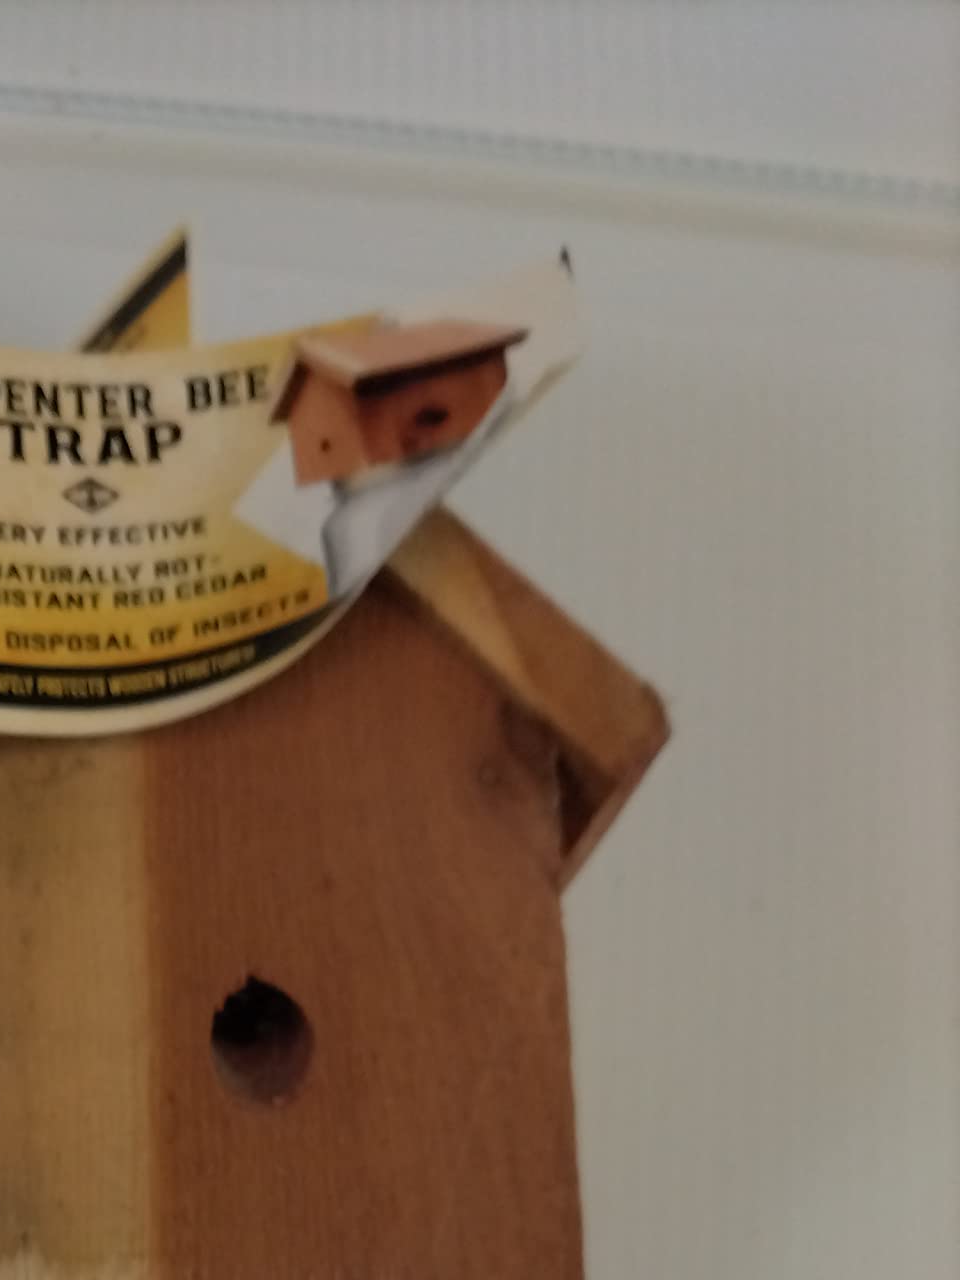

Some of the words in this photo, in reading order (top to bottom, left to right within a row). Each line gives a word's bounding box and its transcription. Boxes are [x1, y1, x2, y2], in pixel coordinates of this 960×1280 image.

[187, 365, 269, 414] BEE
[57, 515, 206, 546] EFFECTIVE
[113, 585, 166, 609] RED
[174, 562, 268, 599] CEDAR
[4, 631, 133, 652] DISPOSAL
[149, 623, 182, 645] OF
[193, 588, 311, 638] INSECTS
